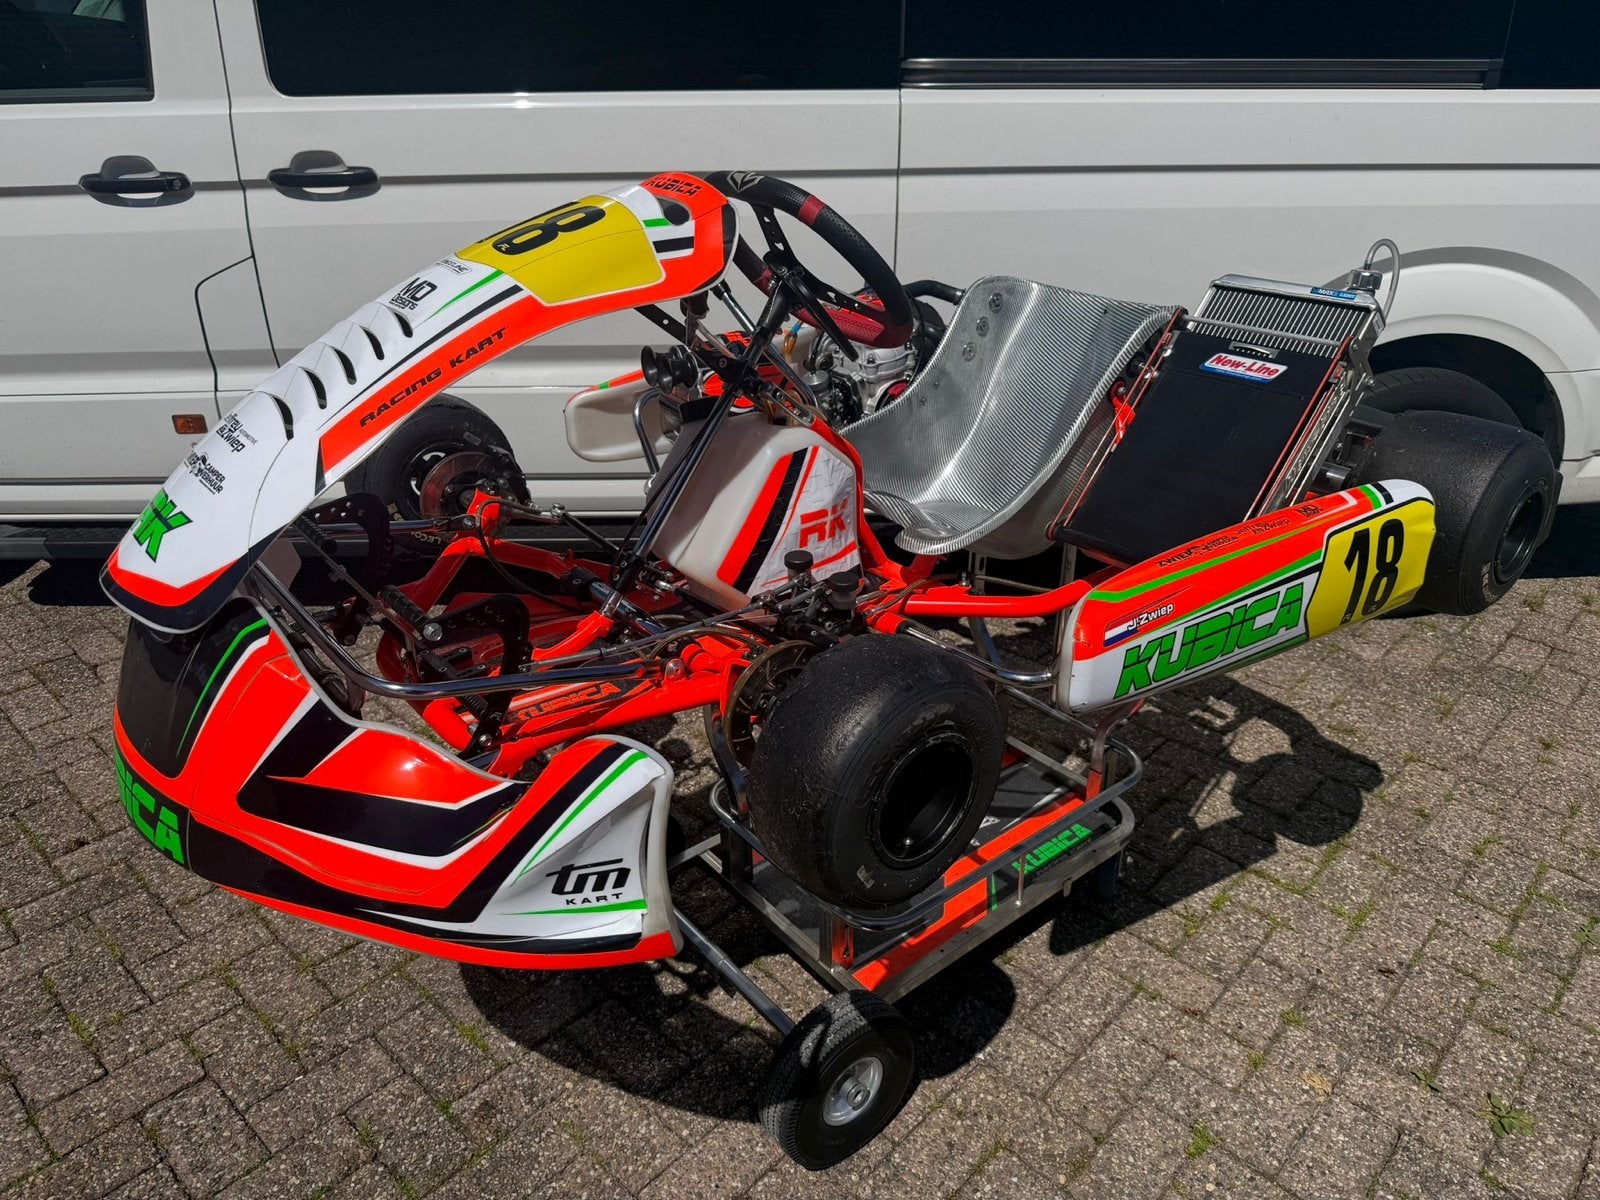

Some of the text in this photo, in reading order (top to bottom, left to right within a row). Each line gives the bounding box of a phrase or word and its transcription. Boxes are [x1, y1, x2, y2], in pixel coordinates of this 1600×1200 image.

[646, 176, 702, 197] KUBICA
[400, 277, 438, 302] MD
[359, 326, 507, 427] RACING KART
[1210, 354, 1281, 378] New-Line
[198, 468, 224, 494] VERHUUR
[204, 463, 226, 484] CAMPER
[799, 498, 849, 549] RK
[410, 531, 442, 545] LECO
[1339, 518, 1404, 626] 18
[1113, 582, 1304, 700] KUBICA
[1011, 823, 1095, 875] KUBICA
[546, 858, 631, 895] tm
[566, 892, 624, 906] KART
